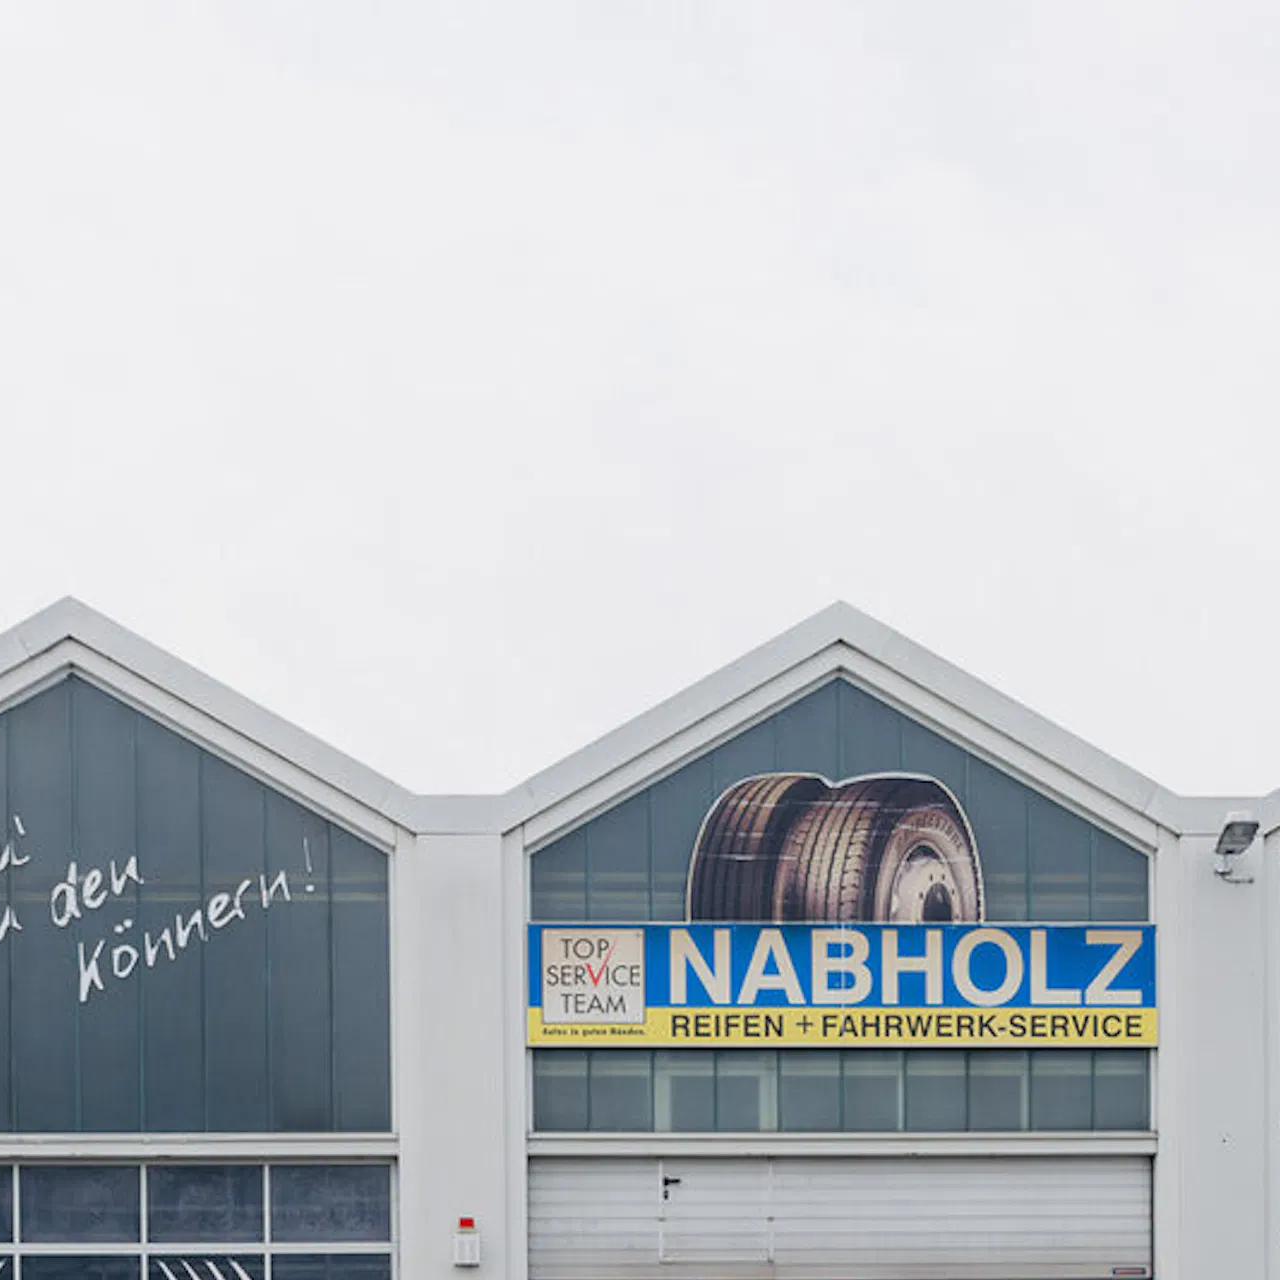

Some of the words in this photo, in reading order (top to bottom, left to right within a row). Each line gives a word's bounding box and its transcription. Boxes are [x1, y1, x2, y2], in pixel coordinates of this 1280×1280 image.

[51, 856, 144, 927] den
[77, 837, 315, 1002] Könnern!
[561, 938, 609, 960] TOP
[547, 963, 640, 987] SERVICE
[670, 927, 1143, 1007] NABHOLZ
[562, 994, 626, 1014] TEAM
[672, 1014, 783, 1037] REIFEN
[796, 1016, 813, 1034] +
[822, 1014, 1143, 1037] FAHRWERK-SERVICE
